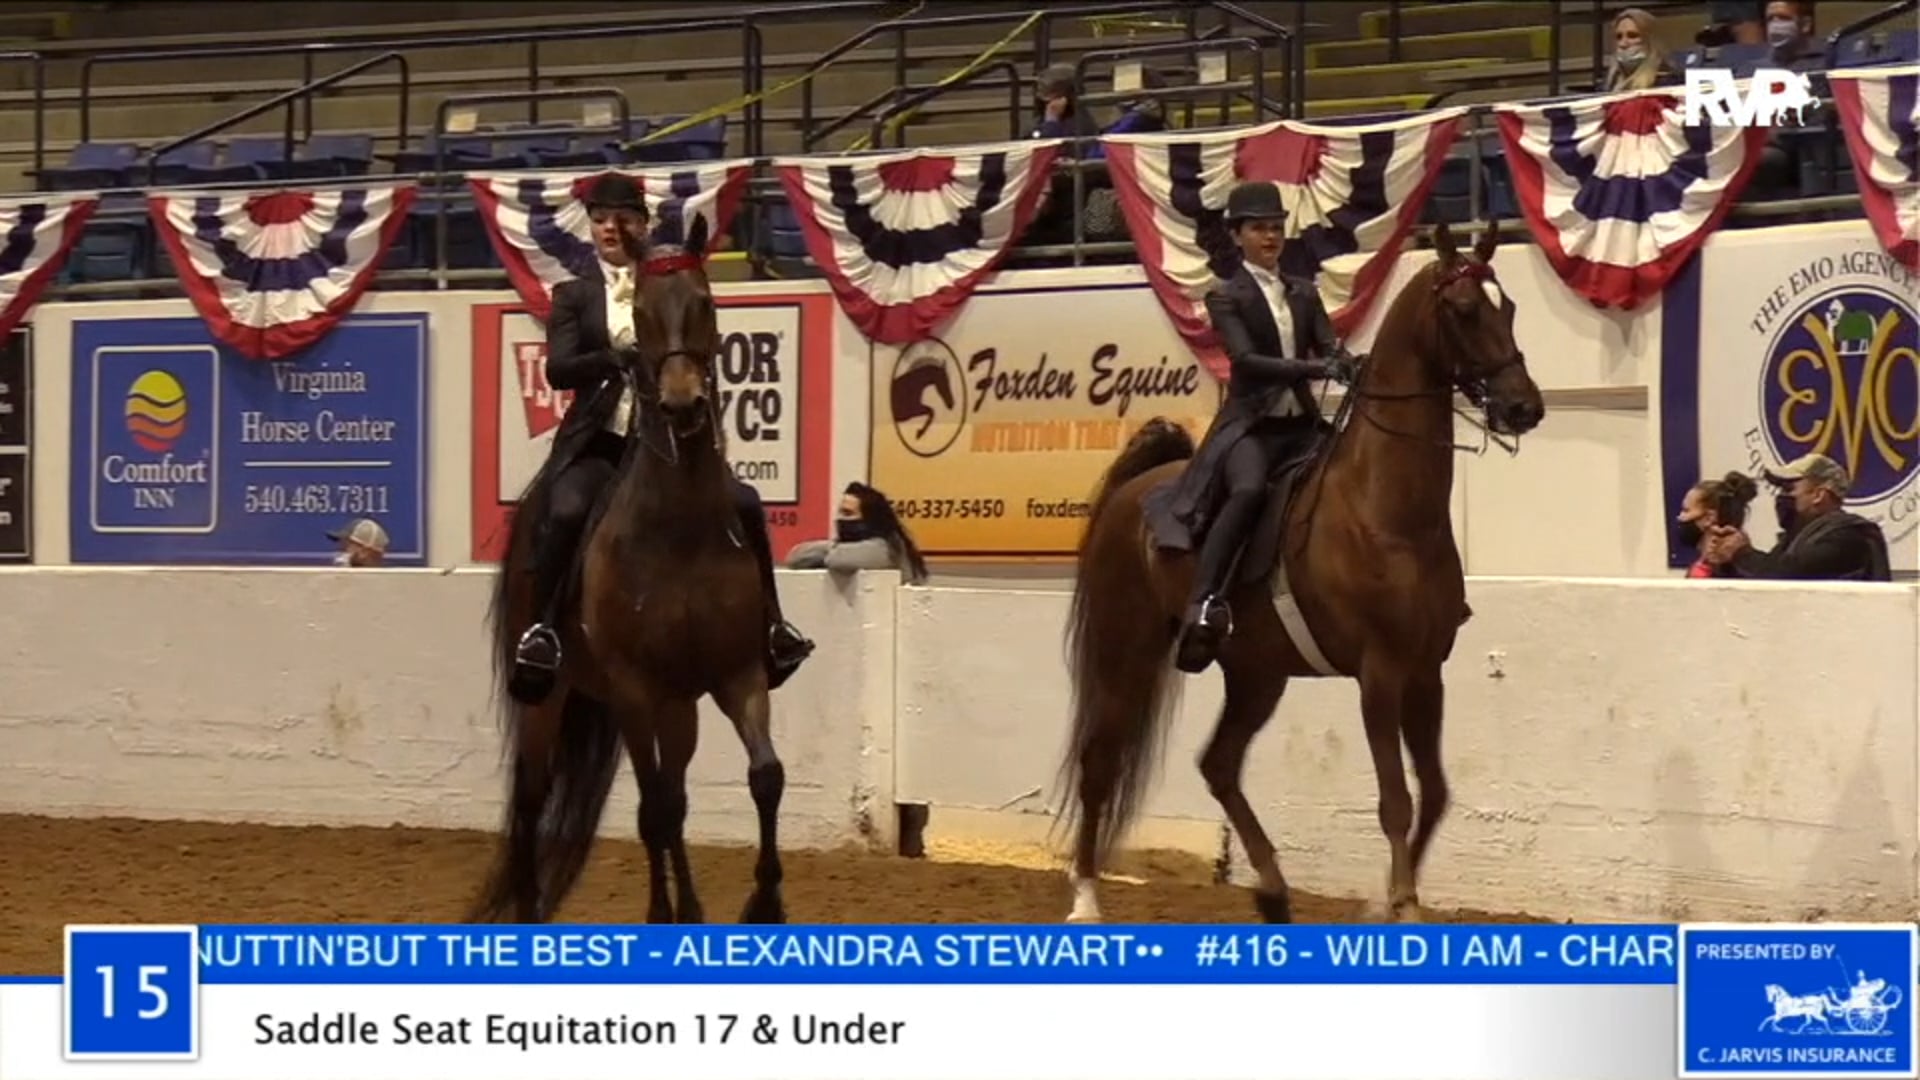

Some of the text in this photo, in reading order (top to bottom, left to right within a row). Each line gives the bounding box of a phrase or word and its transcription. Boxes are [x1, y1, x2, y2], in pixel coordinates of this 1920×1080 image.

[1752, 285, 1790, 335] THE
[1788, 256, 1834, 296] EMO
[271, 361, 366, 399] Virginia
[968, 343, 1199, 418] Foxden Equine
[240, 409, 395, 443] Horse Center
[103, 452, 207, 484] Comfort
[134, 488, 175, 508] INN
[244, 484, 389, 513] 540.463.7311
[889, 499, 1004, 518] 40-337-5450
